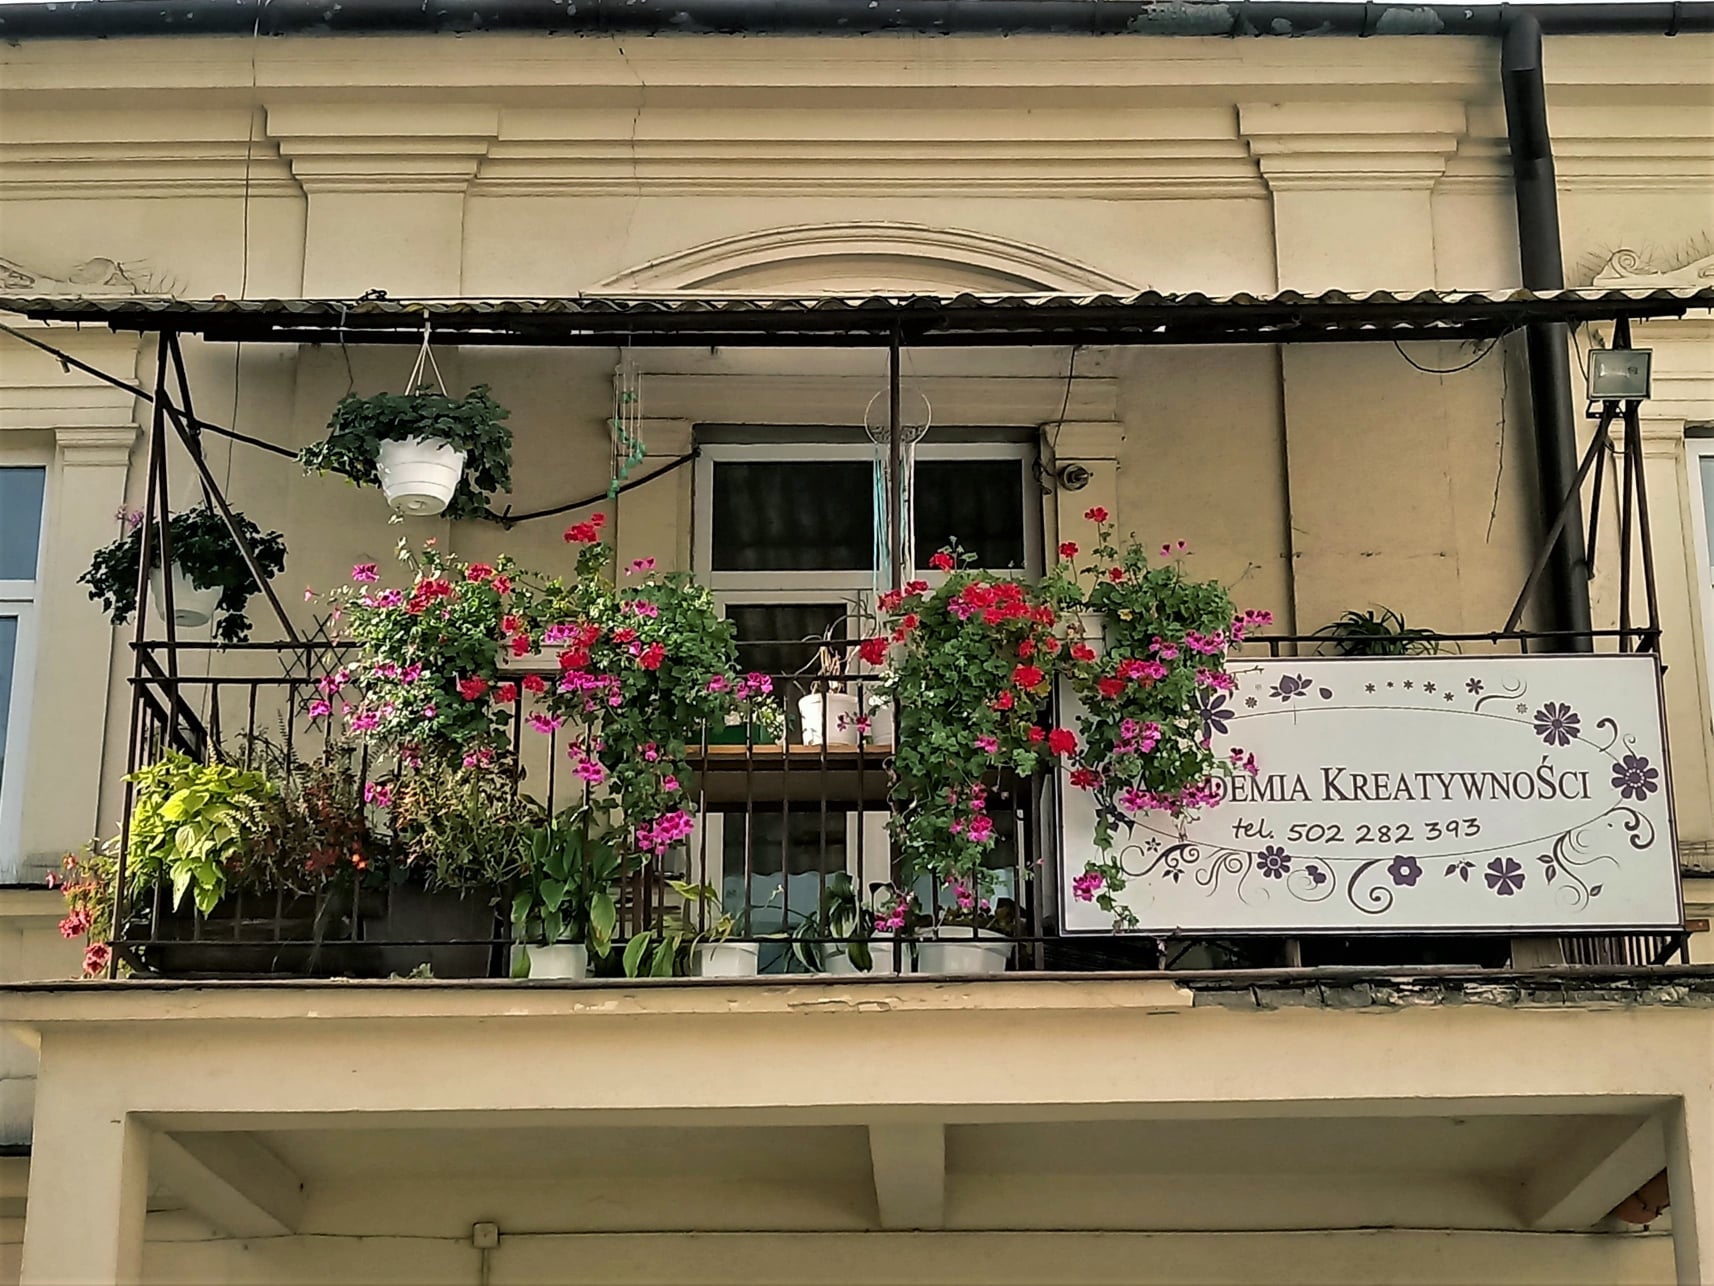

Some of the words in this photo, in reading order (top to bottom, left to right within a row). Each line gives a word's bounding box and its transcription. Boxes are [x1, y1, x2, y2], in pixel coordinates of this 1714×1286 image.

[1132, 768, 1312, 803] ADEMIA
[1320, 755, 1592, 802] KREATYWNOŚCI
[1232, 817, 1274, 840] tel.
[1287, 822, 1345, 843] 502
[1355, 823, 1414, 844] 282
[1424, 817, 1481, 841] 393
